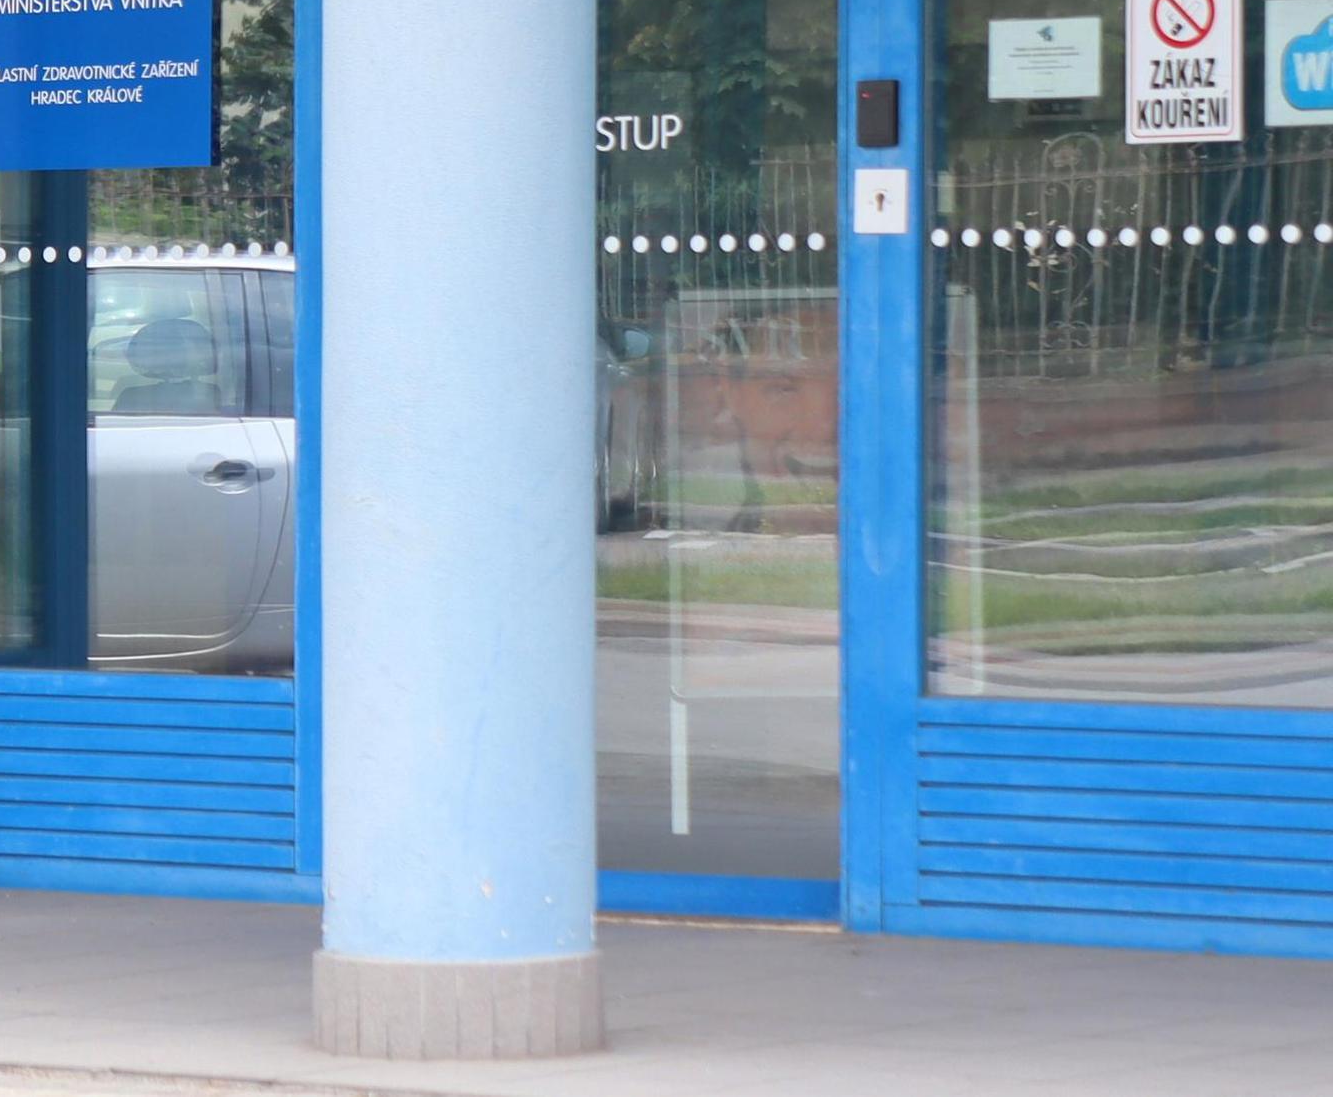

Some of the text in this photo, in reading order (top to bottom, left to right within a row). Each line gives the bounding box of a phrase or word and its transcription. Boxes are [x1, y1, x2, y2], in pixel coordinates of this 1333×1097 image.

[42, 61, 135, 82] ZDRAVOTNICKÉ
[141, 59, 199, 79] ZAŘÍZENÍ
[1150, 53, 1216, 89] ZÁKAZ
[1292, 51, 1333, 92] W
[31, 85, 142, 106] HRADEC KRÁLOVÉ
[1137, 90, 1228, 129] KOUŘENÍ
